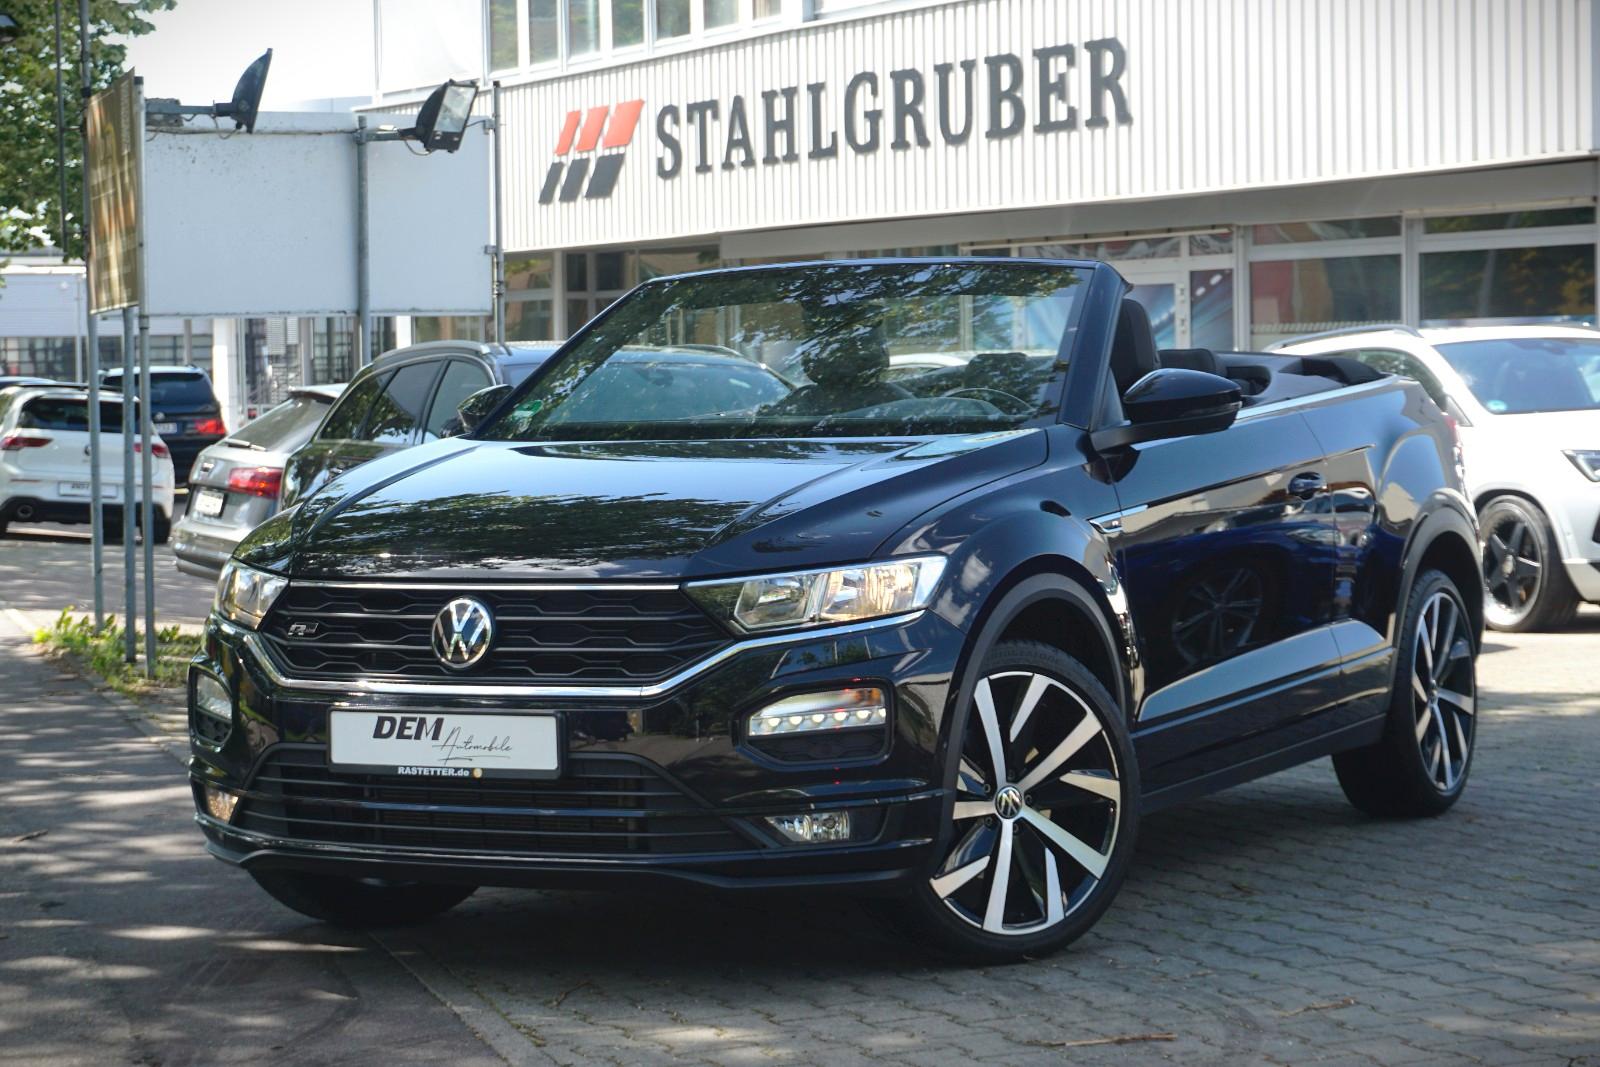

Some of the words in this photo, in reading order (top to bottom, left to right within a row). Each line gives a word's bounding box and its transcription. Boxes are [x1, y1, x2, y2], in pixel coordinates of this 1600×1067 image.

[656, 37, 1133, 180] STAHLGRUBER
[372, 715, 444, 741] DEM
[432, 726, 512, 765] Automobile
